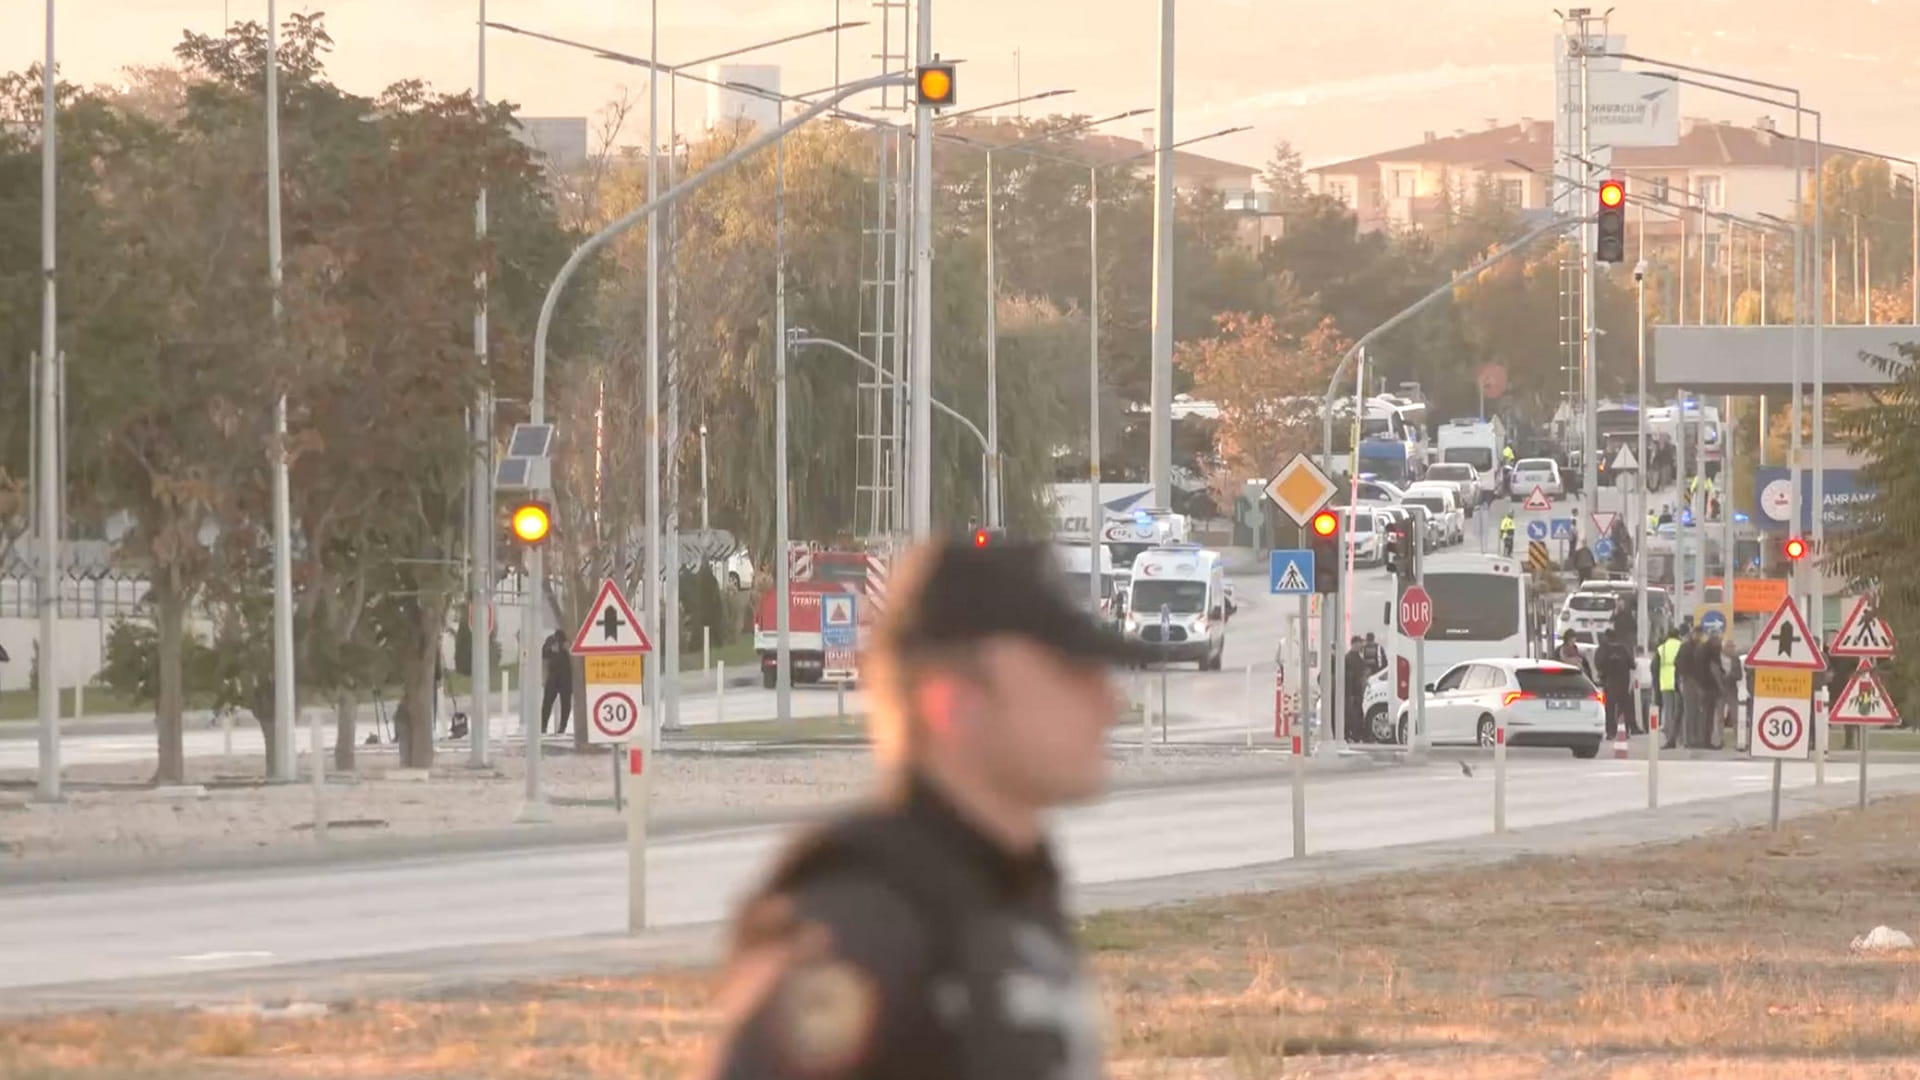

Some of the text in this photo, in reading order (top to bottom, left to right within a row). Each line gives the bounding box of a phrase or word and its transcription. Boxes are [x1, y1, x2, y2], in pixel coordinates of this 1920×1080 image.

[1402, 601, 1430, 623] DUR
[602, 703, 628, 723] 30
[1768, 717, 1794, 738] 30
